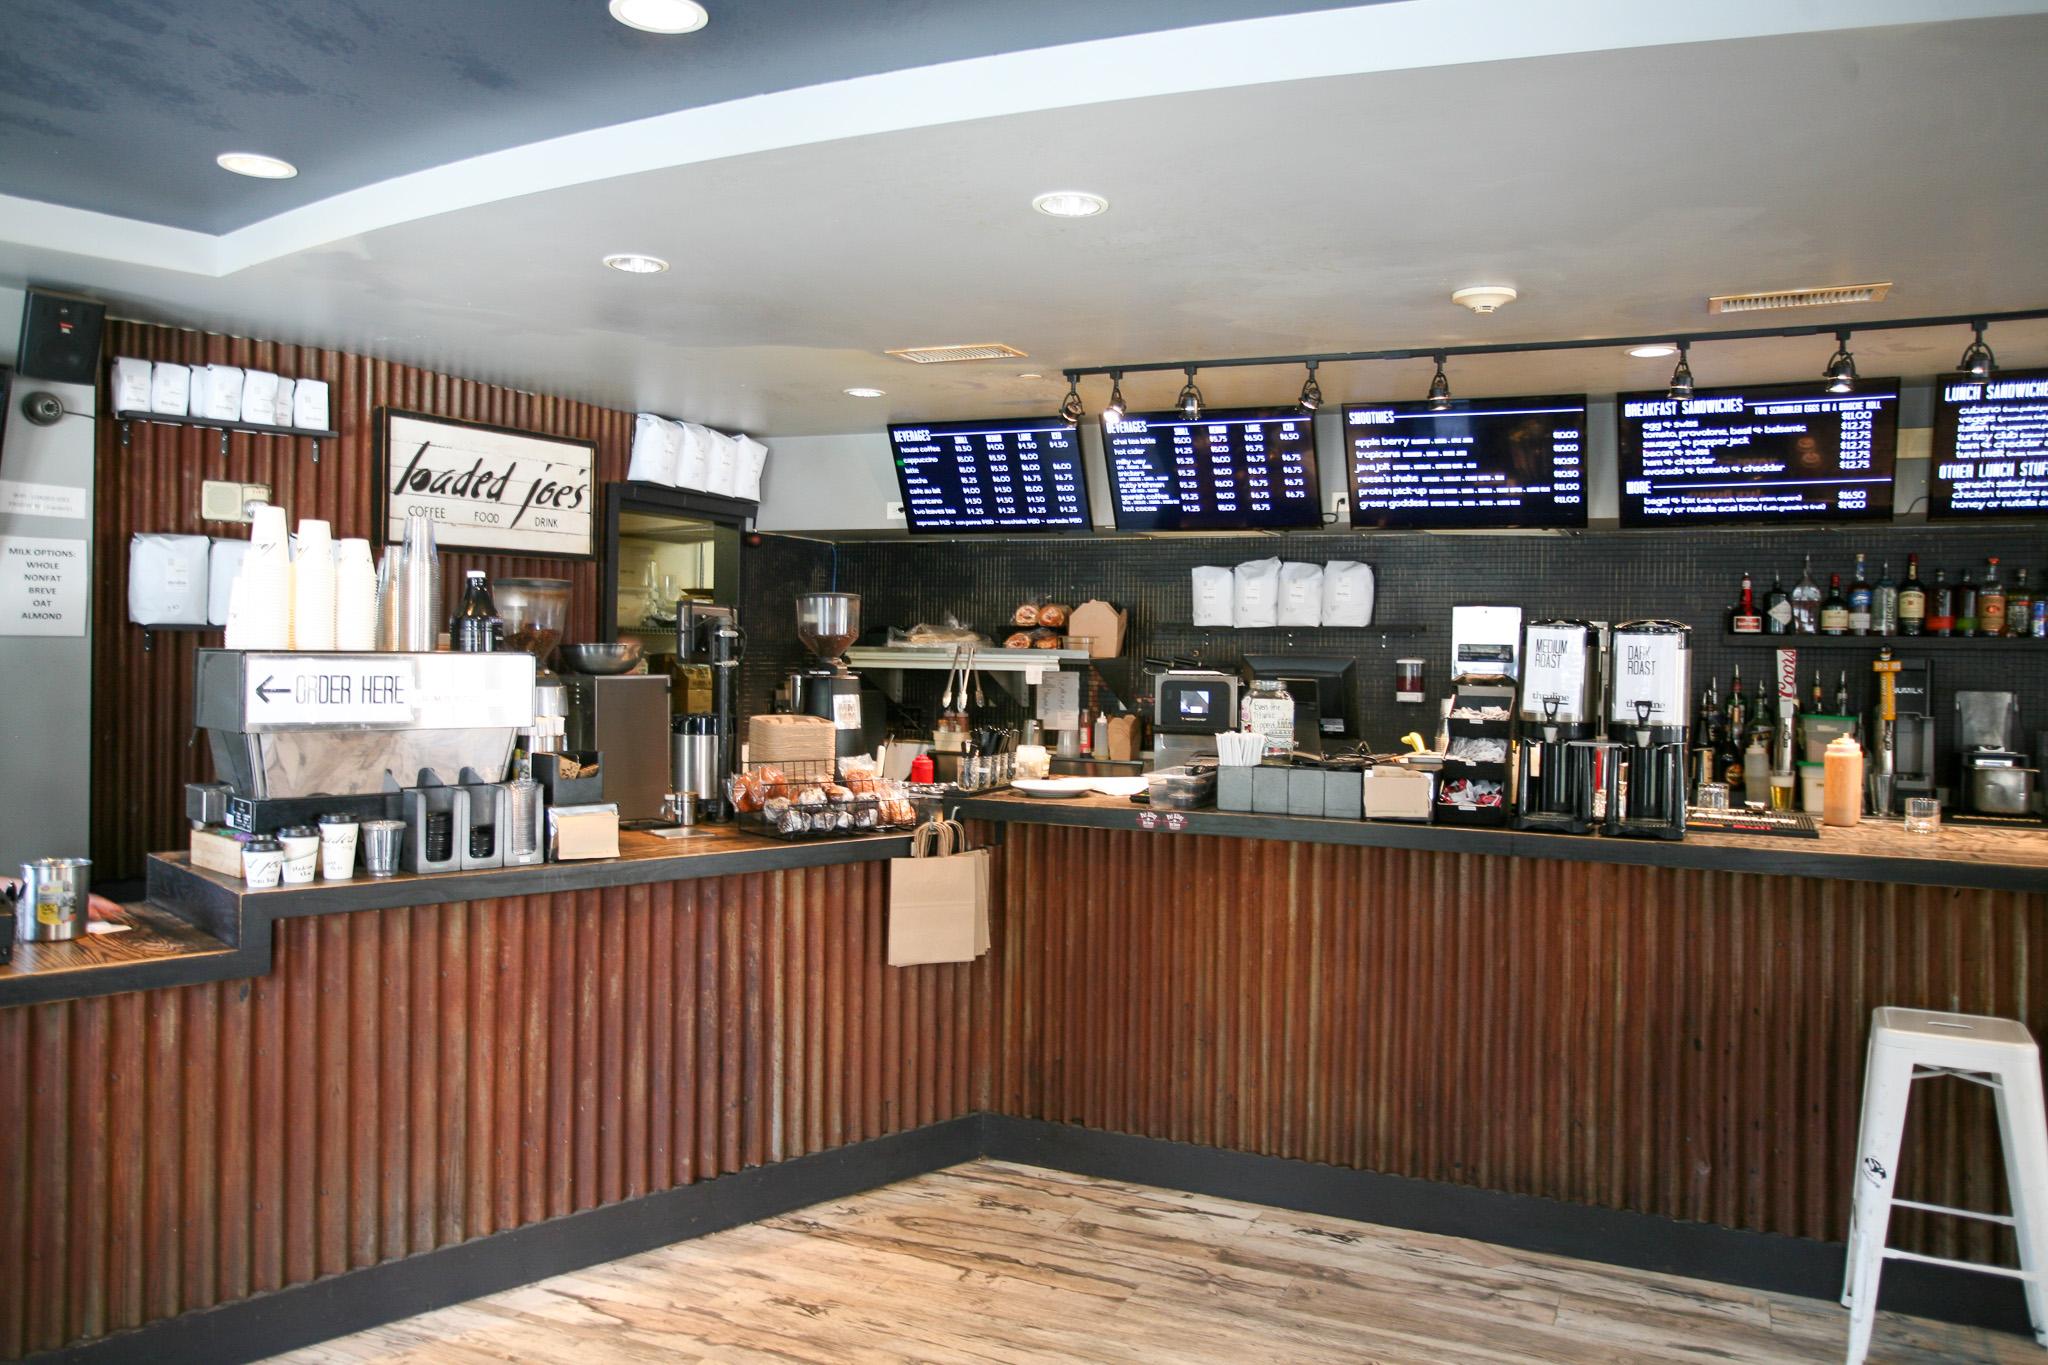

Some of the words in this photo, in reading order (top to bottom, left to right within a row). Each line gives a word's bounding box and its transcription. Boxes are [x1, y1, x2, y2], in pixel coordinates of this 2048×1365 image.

[1945, 386, 1981, 401] LUNCH
[1625, 401, 1677, 417] BREAKFAST
[1680, 398, 1743, 414] SANDWICHES
[1804, 404, 1819, 412] EGGS
[1959, 406, 2001, 414] cubano
[1349, 411, 1395, 424] SMOOTHIES
[1959, 415, 1996, 426] veggie
[1105, 421, 1147, 434] BEVERAGES
[1730, 427, 1752, 435] basil
[1764, 425, 1806, 433] balsamic
[1841, 421, 1871, 430] $12.75
[894, 430, 932, 442] BEVERAGES
[1693, 439, 1727, 447] pepper
[1727, 437, 1749, 447] jack
[1841, 431, 1871, 440] $12.75
[1957, 433, 1993, 443] turkey
[1994, 431, 2018, 439] club
[1355, 438, 1380, 448] apple
[1381, 438, 1409, 447] berry
[1685, 446, 1709, 456] swiss
[1840, 441, 1870, 449] $12.75
[1956, 442, 1979, 450] ham
[1993, 439, 2043, 448] cheddar
[1356, 451, 1400, 460] tropicana
[1674, 457, 1715, 465] cheddar
[1840, 451, 1870, 459] $12.75
[1643, 467, 1684, 475] avocado
[1696, 466, 1730, 474] tomato
[1742, 464, 1785, 472] cheddar
[1839, 460, 1870, 469] $12.75
[1939, 464, 1974, 479] OTHER
[1979, 463, 2015, 477] LUNCH
[393, 441, 517, 503] loaded
[510, 463, 588, 529] joe's
[1626, 481, 1651, 494] MORE
[1953, 481, 1995, 492] spinach
[1996, 479, 2025, 487] salad
[1358, 488, 1392, 497] protein
[1952, 490, 1994, 498] chicken
[1996, 489, 2040, 497] tenders
[1360, 501, 1387, 509] green
[1644, 497, 1670, 506] bagel
[1952, 501, 1985, 509] honey
[408, 505, 446, 519] COFFEE
[474, 511, 500, 524] FOOD
[535, 517, 558, 528] DRINK
[1644, 507, 1673, 515] honey
[9, 548, 32, 556] MILK
[34, 549, 76, 558] OPTIONS:
[26, 561, 59, 570] WHOLE
[24, 574, 62, 582] NONFAT
[28, 587, 57, 595] BREVE
[21, 612, 62, 620] ALMOND
[1536, 639, 1568, 654] MEDIUM
[1627, 645, 1651, 660] DARK
[1535, 653, 1562, 668] ROAST
[1627, 660, 1657, 676] ROAST
[1778, 650, 1797, 698] Coors
[296, 675, 351, 704] ORDER
[362, 675, 405, 704] HERE
